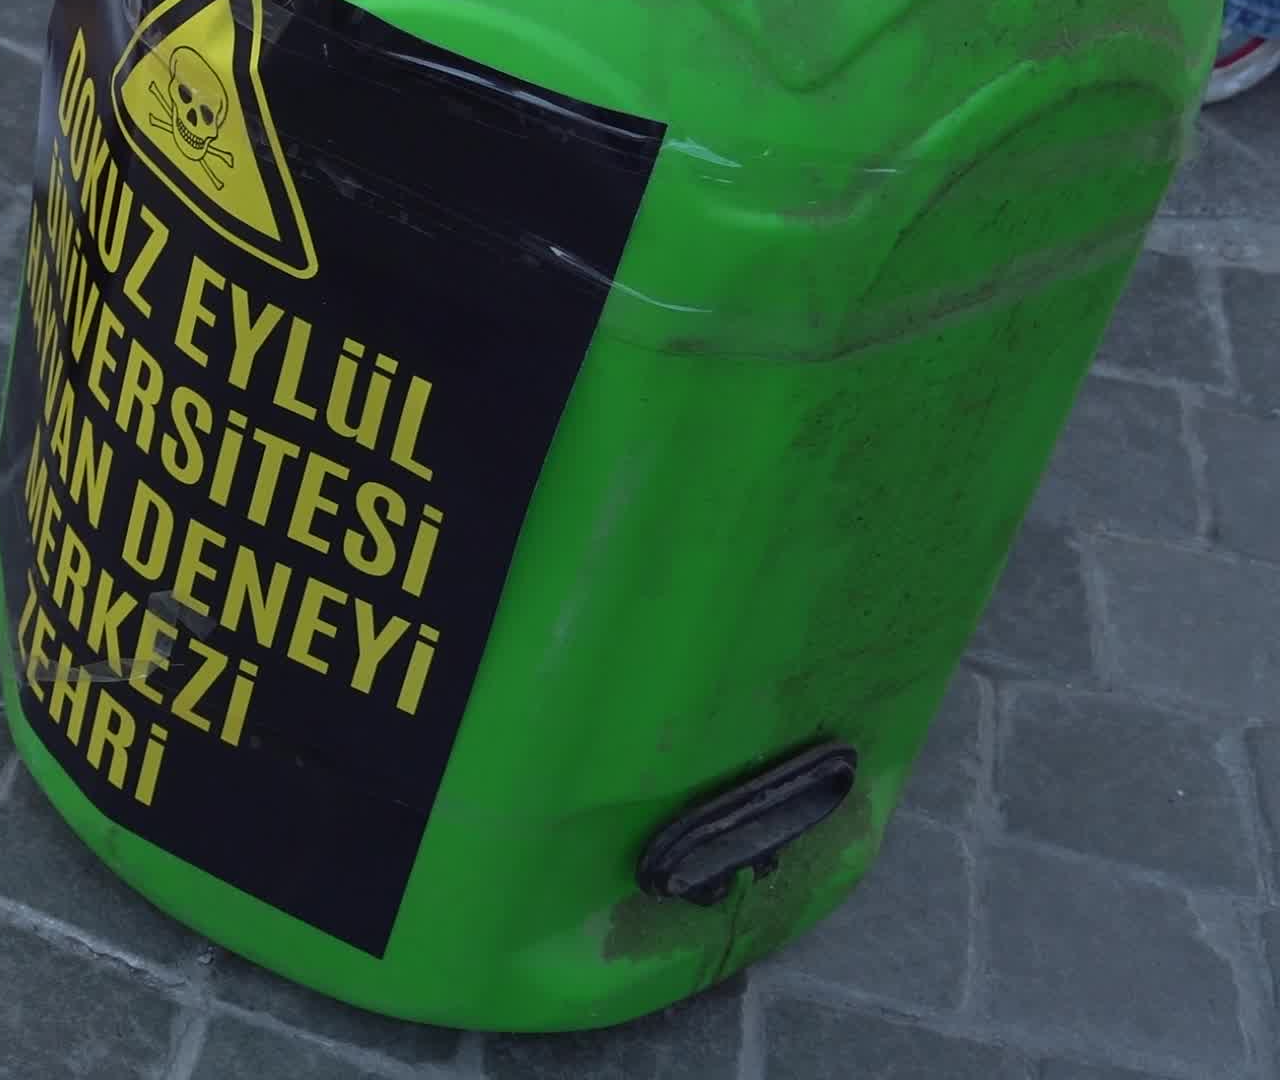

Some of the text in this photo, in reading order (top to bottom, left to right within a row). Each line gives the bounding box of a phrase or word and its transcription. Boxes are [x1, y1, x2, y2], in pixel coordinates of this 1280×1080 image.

[26, 199, 440, 716] HAYVAN DENEYİ
[46, 136, 445, 598] ÜNİVERSİTESİ
[58, 27, 433, 482] DOKUZ EYLÜL
[18, 568, 168, 806] ZEHRİ
[25, 424, 259, 747] MERKEZİ
